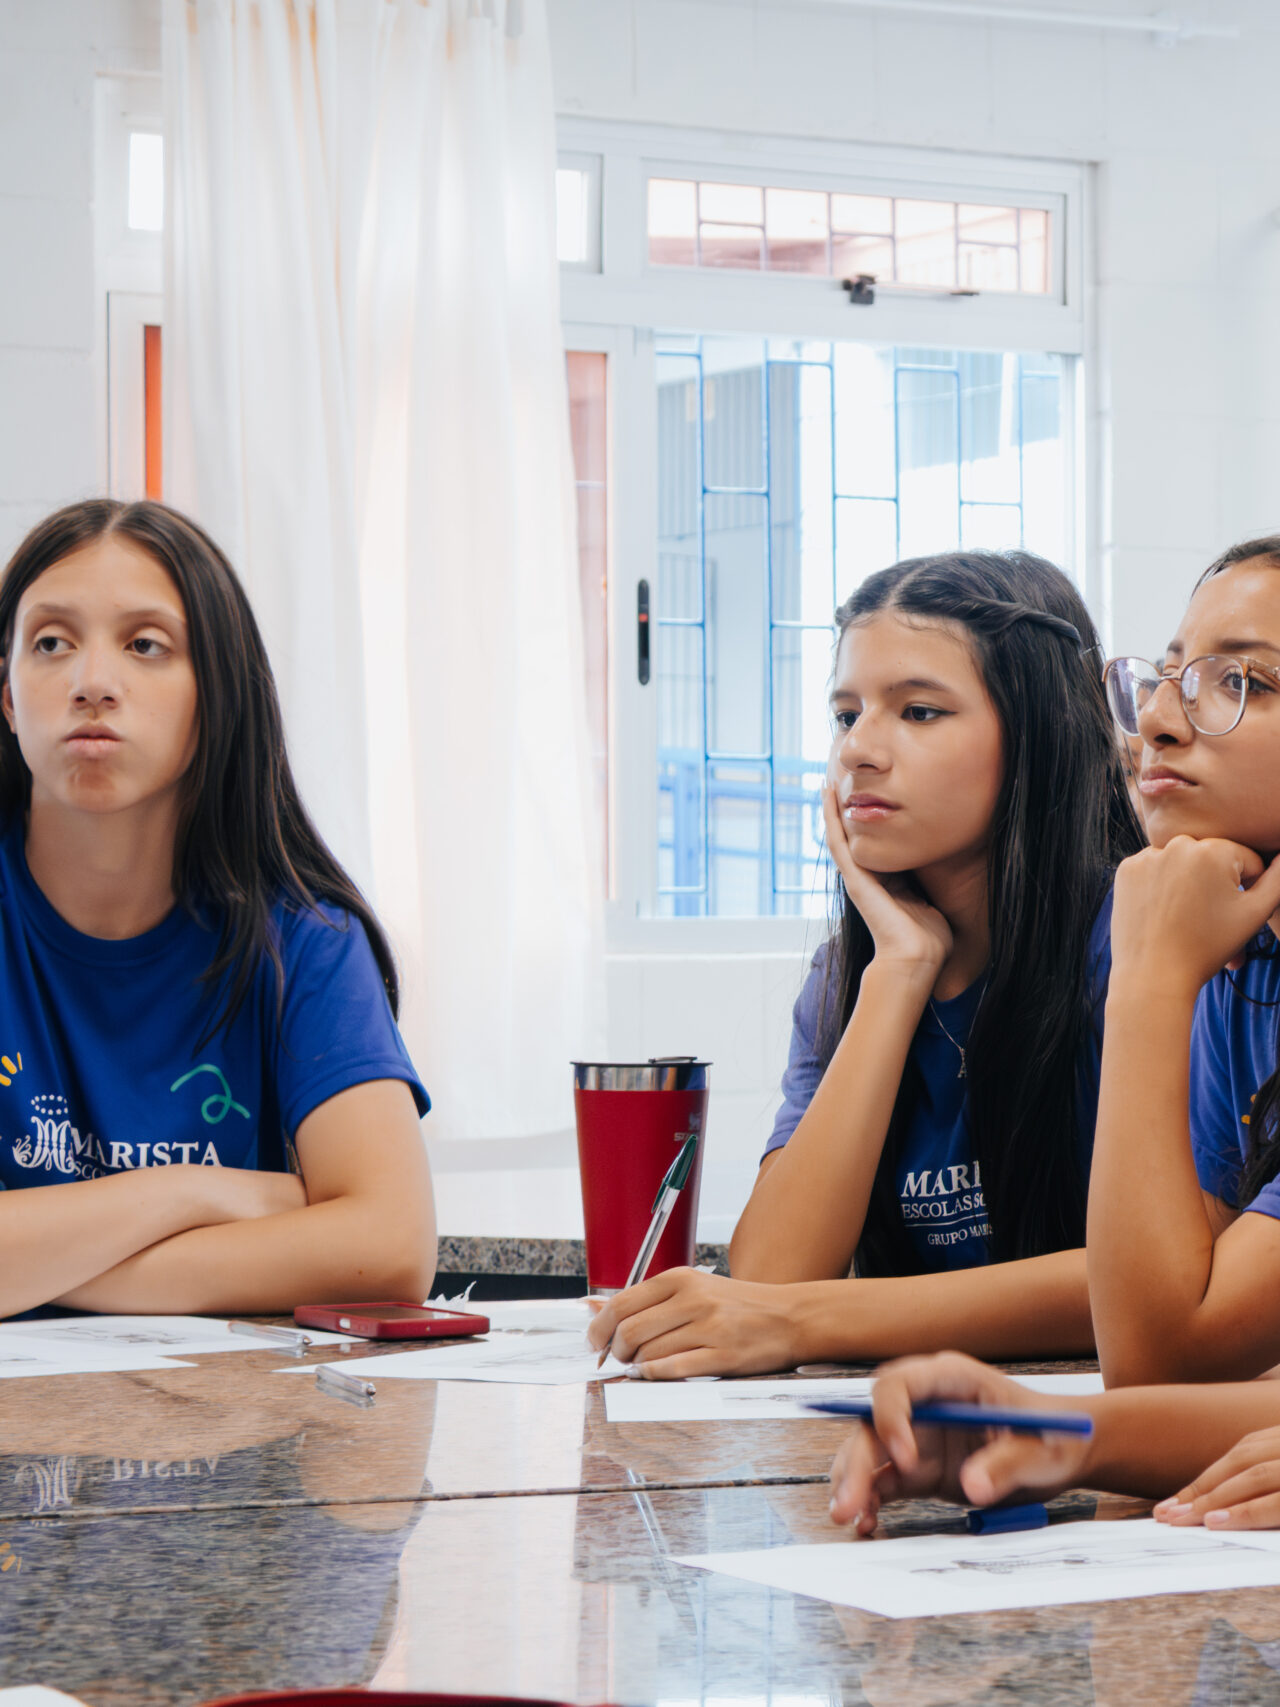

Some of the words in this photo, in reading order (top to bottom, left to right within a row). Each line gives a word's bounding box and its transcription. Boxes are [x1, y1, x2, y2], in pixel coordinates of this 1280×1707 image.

[900, 1160, 982, 1197] MARI
[901, 1195, 973, 1219] ESCOLAS
[927, 1229, 968, 1245] GRUPO
